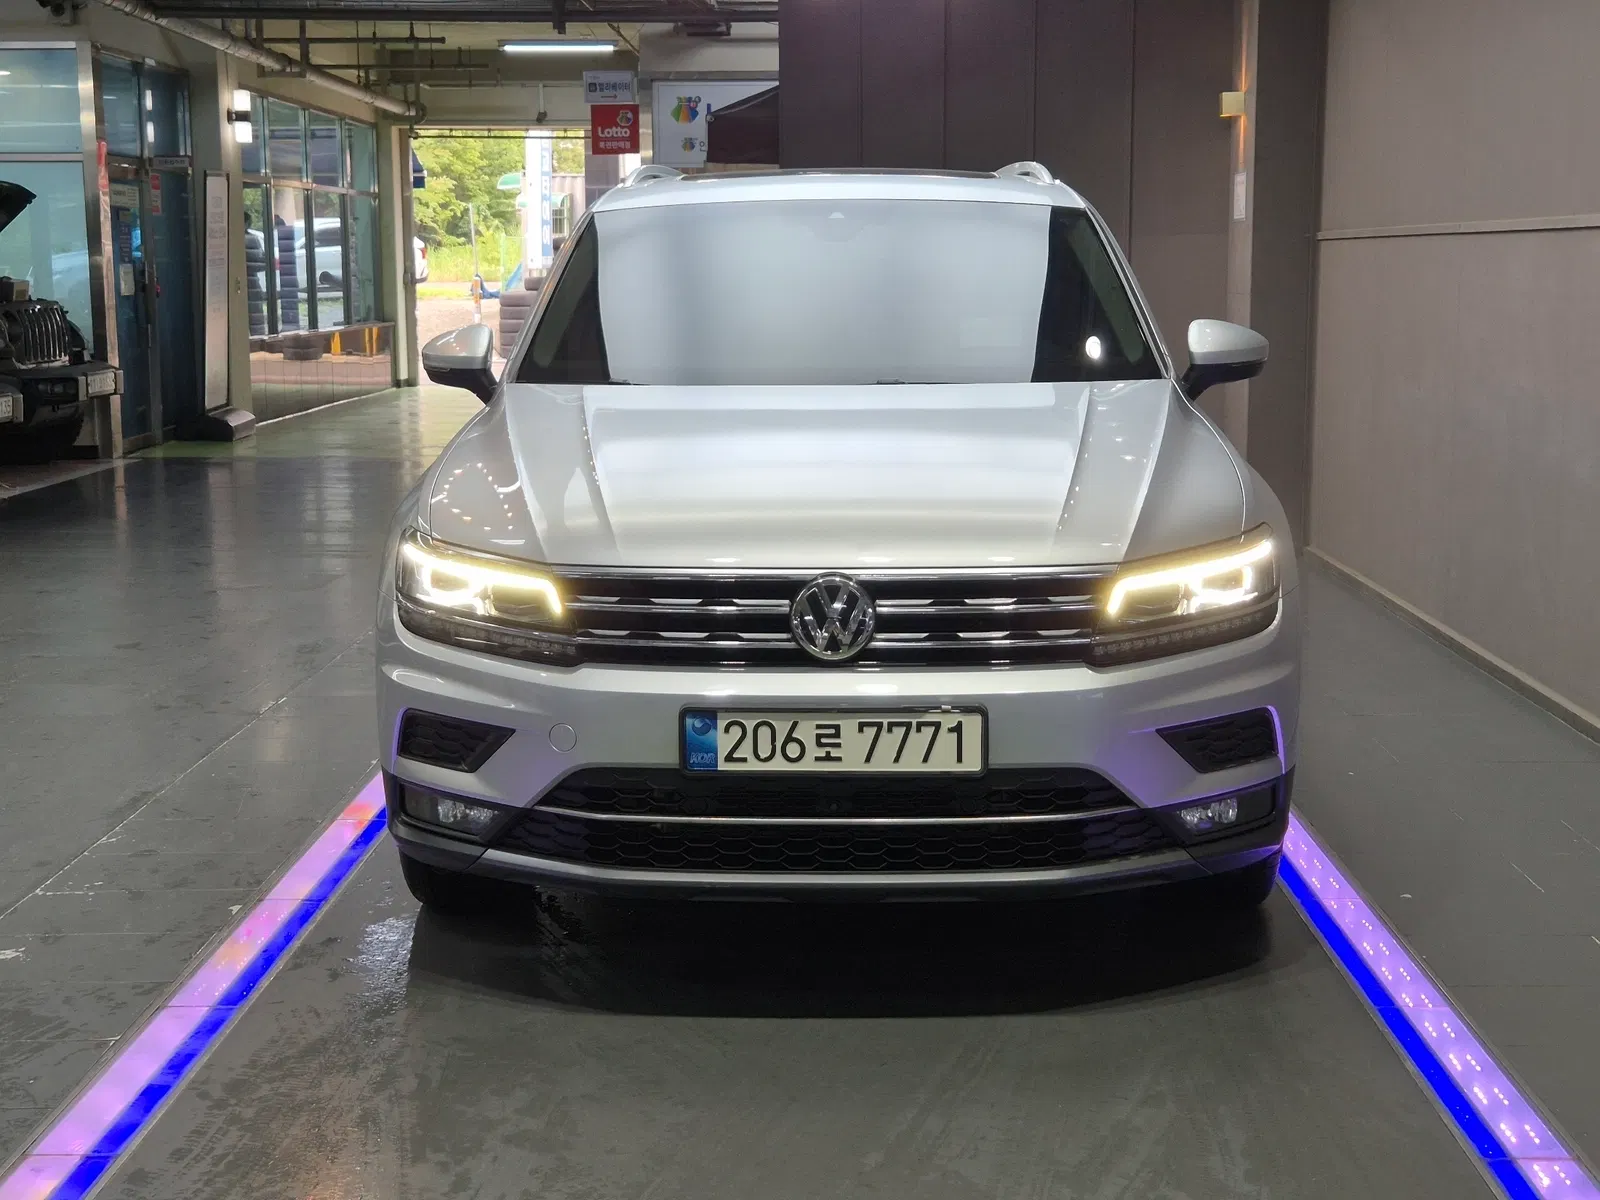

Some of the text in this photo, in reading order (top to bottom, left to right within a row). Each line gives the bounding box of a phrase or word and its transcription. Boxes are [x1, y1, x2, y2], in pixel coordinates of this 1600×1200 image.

[598, 82, 631, 92] 엘리베이터
[598, 126, 631, 137] Lotto
[723, 720, 964, 763] 206로 7771
[689, 752, 716, 764] KOR
